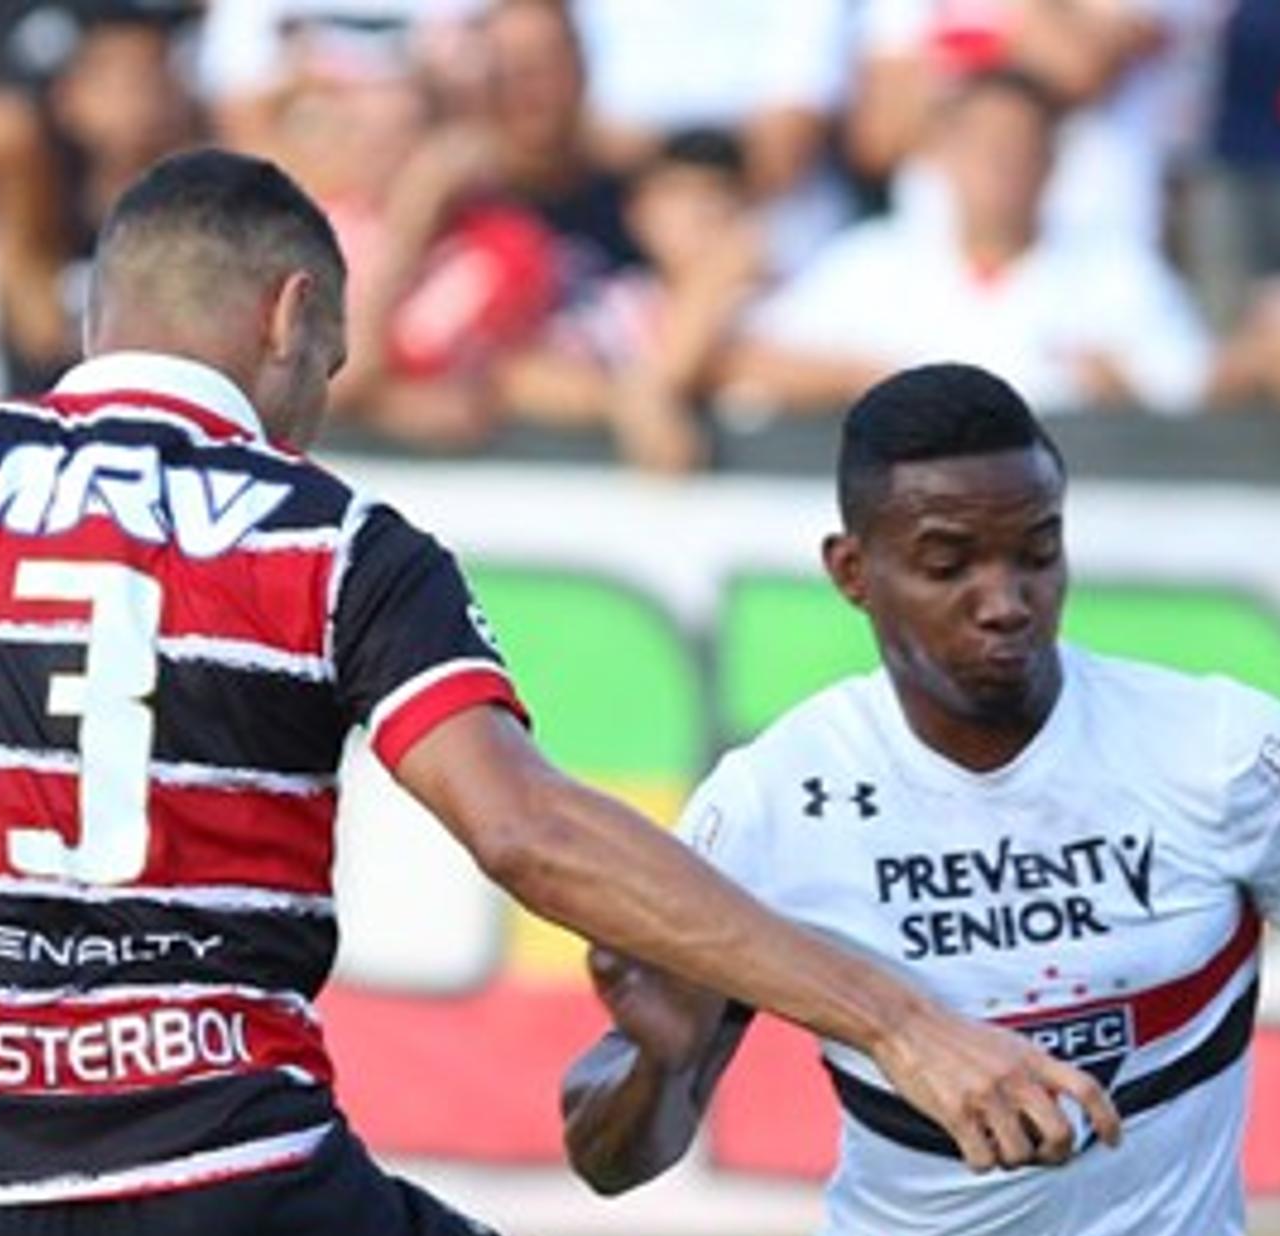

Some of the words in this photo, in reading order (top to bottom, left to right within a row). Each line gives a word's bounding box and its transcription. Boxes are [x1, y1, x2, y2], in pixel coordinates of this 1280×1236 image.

[8, 561, 163, 885] 3
[875, 836, 1107, 902] PREVENT
[901, 896, 1110, 960] SENIOR
[1032, 1016, 1125, 1054] PFC
